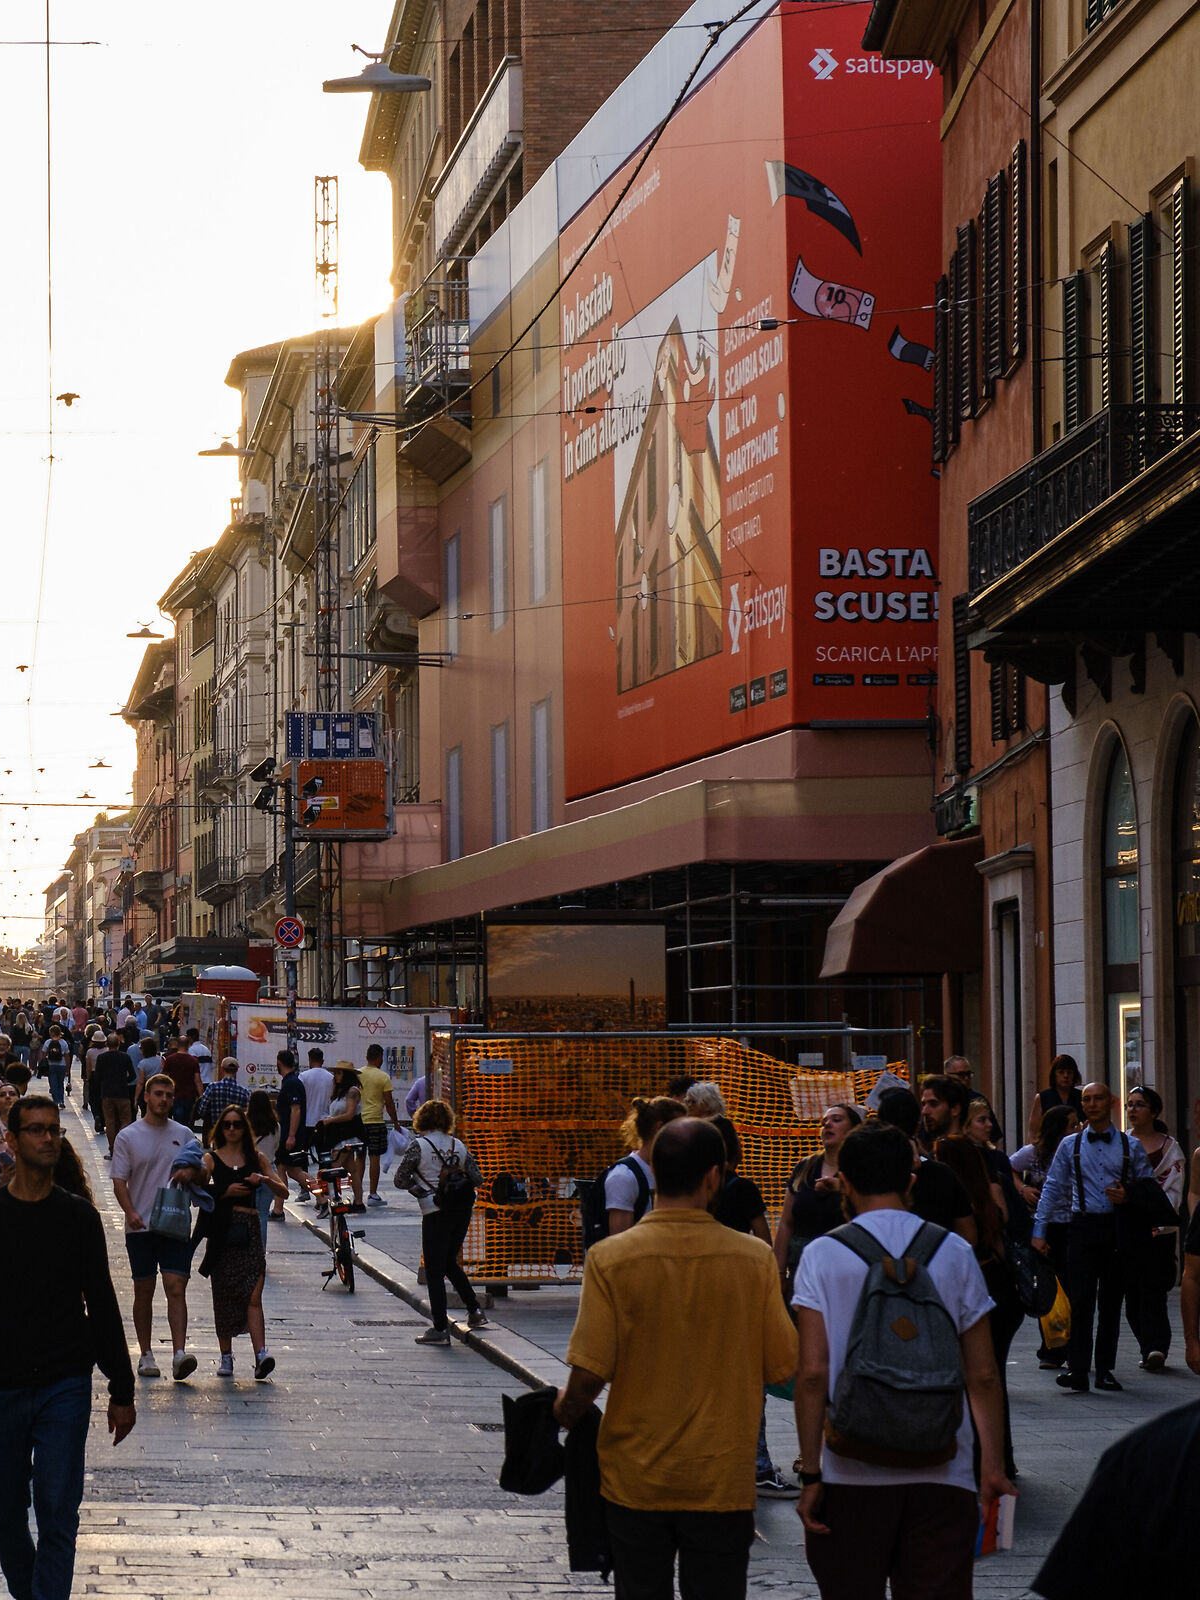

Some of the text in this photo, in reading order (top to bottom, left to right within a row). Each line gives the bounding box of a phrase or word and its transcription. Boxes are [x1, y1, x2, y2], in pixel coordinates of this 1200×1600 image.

[845, 55, 935, 80] satispay
[563, 272, 613, 350] ho lasciato
[826, 285, 847, 306] 10
[724, 295, 773, 357] BASTA SCUSE!
[563, 323, 627, 420] il portafoglio
[724, 333, 784, 399] SCAMBIA SOLDI
[564, 431, 575, 479] in
[575, 419, 599, 470] cima
[599, 399, 618, 455] alla
[725, 394, 757, 441] DAL TUO
[725, 425, 779, 483] SMARTPHONE
[747, 472, 774, 507] GRATUITO
[819, 547, 935, 579] BASTA
[743, 583, 788, 639] satispay
[813, 591, 940, 622] SCUSE!
[815, 646, 892, 663] SCARICA
